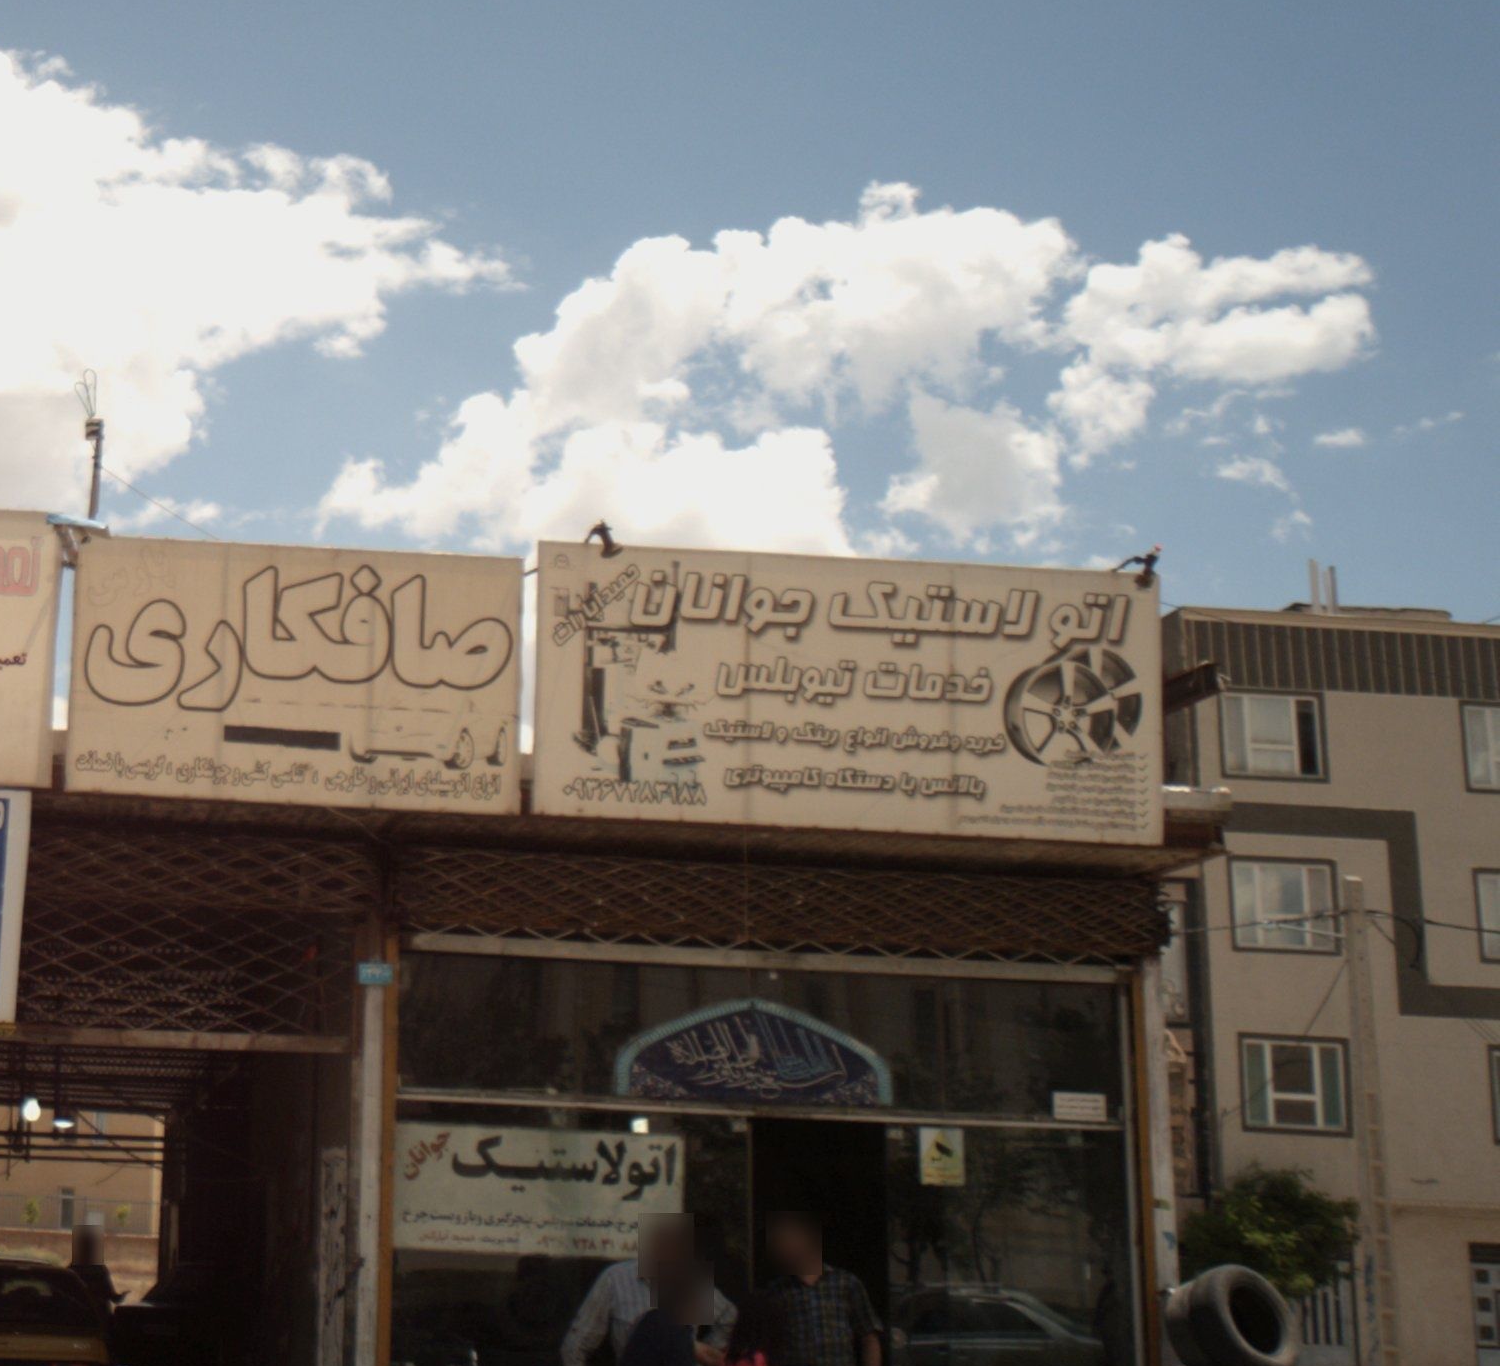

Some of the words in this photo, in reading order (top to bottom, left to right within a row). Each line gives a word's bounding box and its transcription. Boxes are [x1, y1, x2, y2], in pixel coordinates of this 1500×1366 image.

[629, 569, 814, 639] جوانان
[828, 581, 1040, 647] لاستیک
[1050, 591, 1130, 650] اتو
[84, 564, 514, 712] صافکاری
[716, 656, 856, 705] تیوبلس
[863, 662, 993, 703] خدمات
[703, 720, 774, 744] لاستیک
[776, 726, 788, 745] و
[843, 726, 889, 754] انواع
[964, 735, 1006, 758] خرید
[723, 765, 823, 794] کامپیوتری
[824, 767, 896, 791] دستگاه
[900, 771, 918, 797] با
[919, 774, 988, 801] بالانس
[451, 1136, 627, 1193] لاستیک
[620, 1142, 676, 1201] اتو
